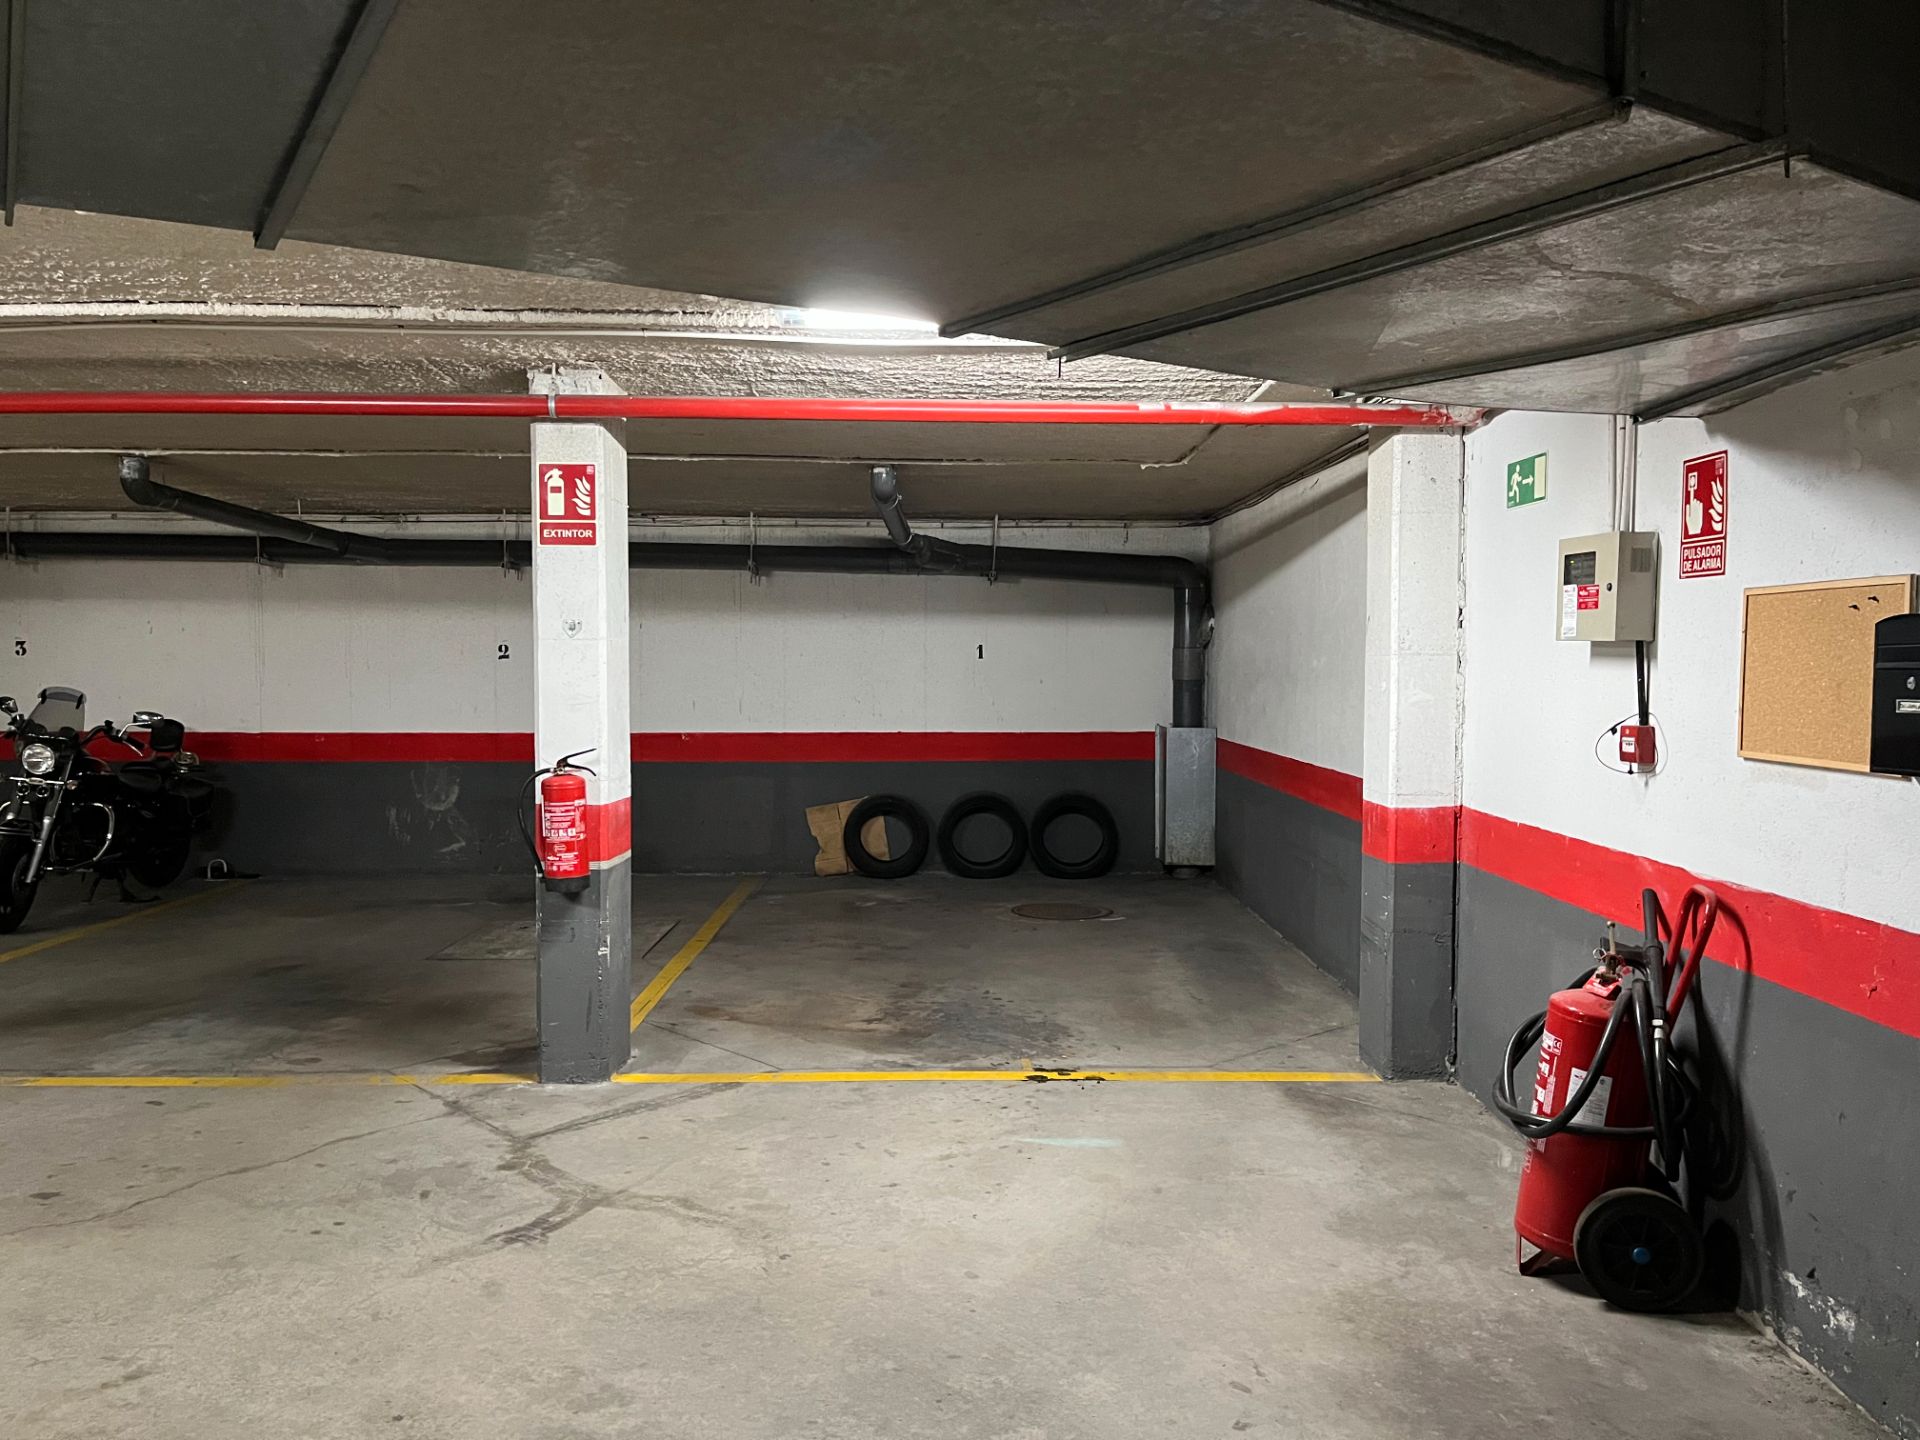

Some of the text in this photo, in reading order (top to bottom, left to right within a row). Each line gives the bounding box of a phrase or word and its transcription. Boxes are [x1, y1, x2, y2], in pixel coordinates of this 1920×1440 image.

[543, 529, 593, 538] EXTINTOR
[1683, 545, 1722, 560] PULSADOR
[1683, 557, 1722, 572] DE ALARMA
[15, 640, 27, 656] 3
[498, 644, 510, 660] 2
[976, 644, 984, 660] 1
